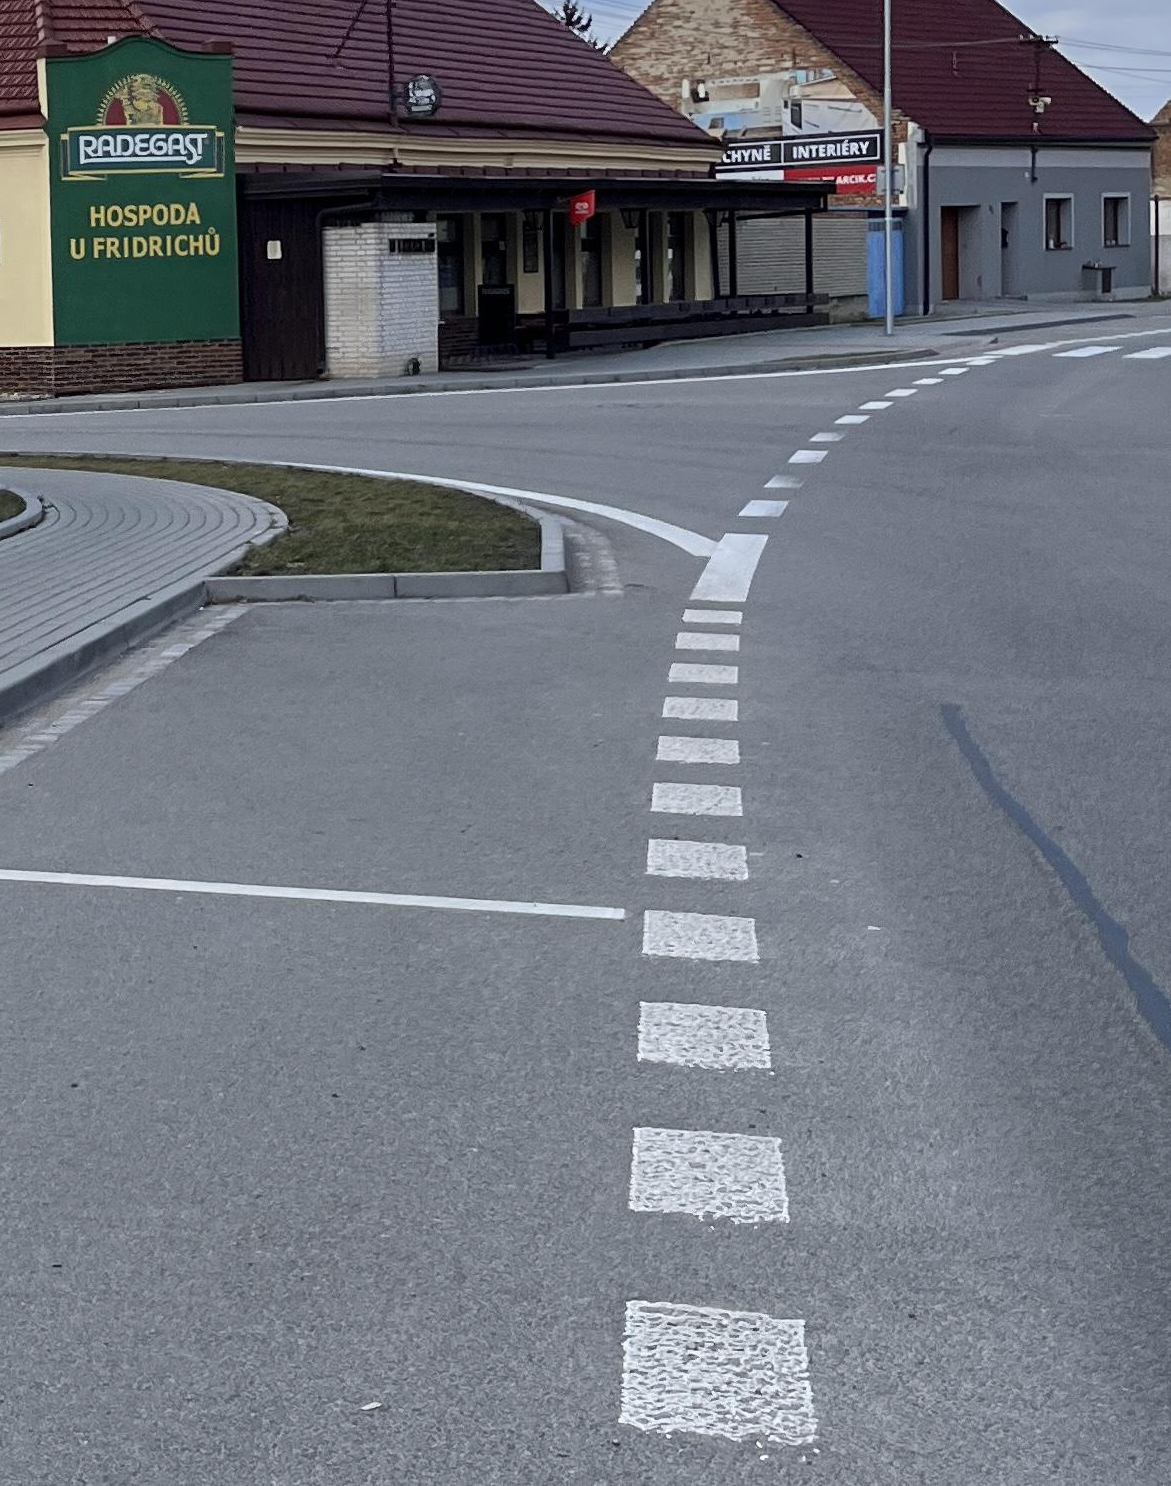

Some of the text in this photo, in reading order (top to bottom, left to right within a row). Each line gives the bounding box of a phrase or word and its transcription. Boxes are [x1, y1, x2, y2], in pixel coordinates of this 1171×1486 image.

[79, 133, 208, 165] RADEGAST
[792, 139, 870, 159] INTERIÉRY
[89, 202, 201, 227] HOSPODA
[70, 226, 220, 260] U FRIDRICHŮ
